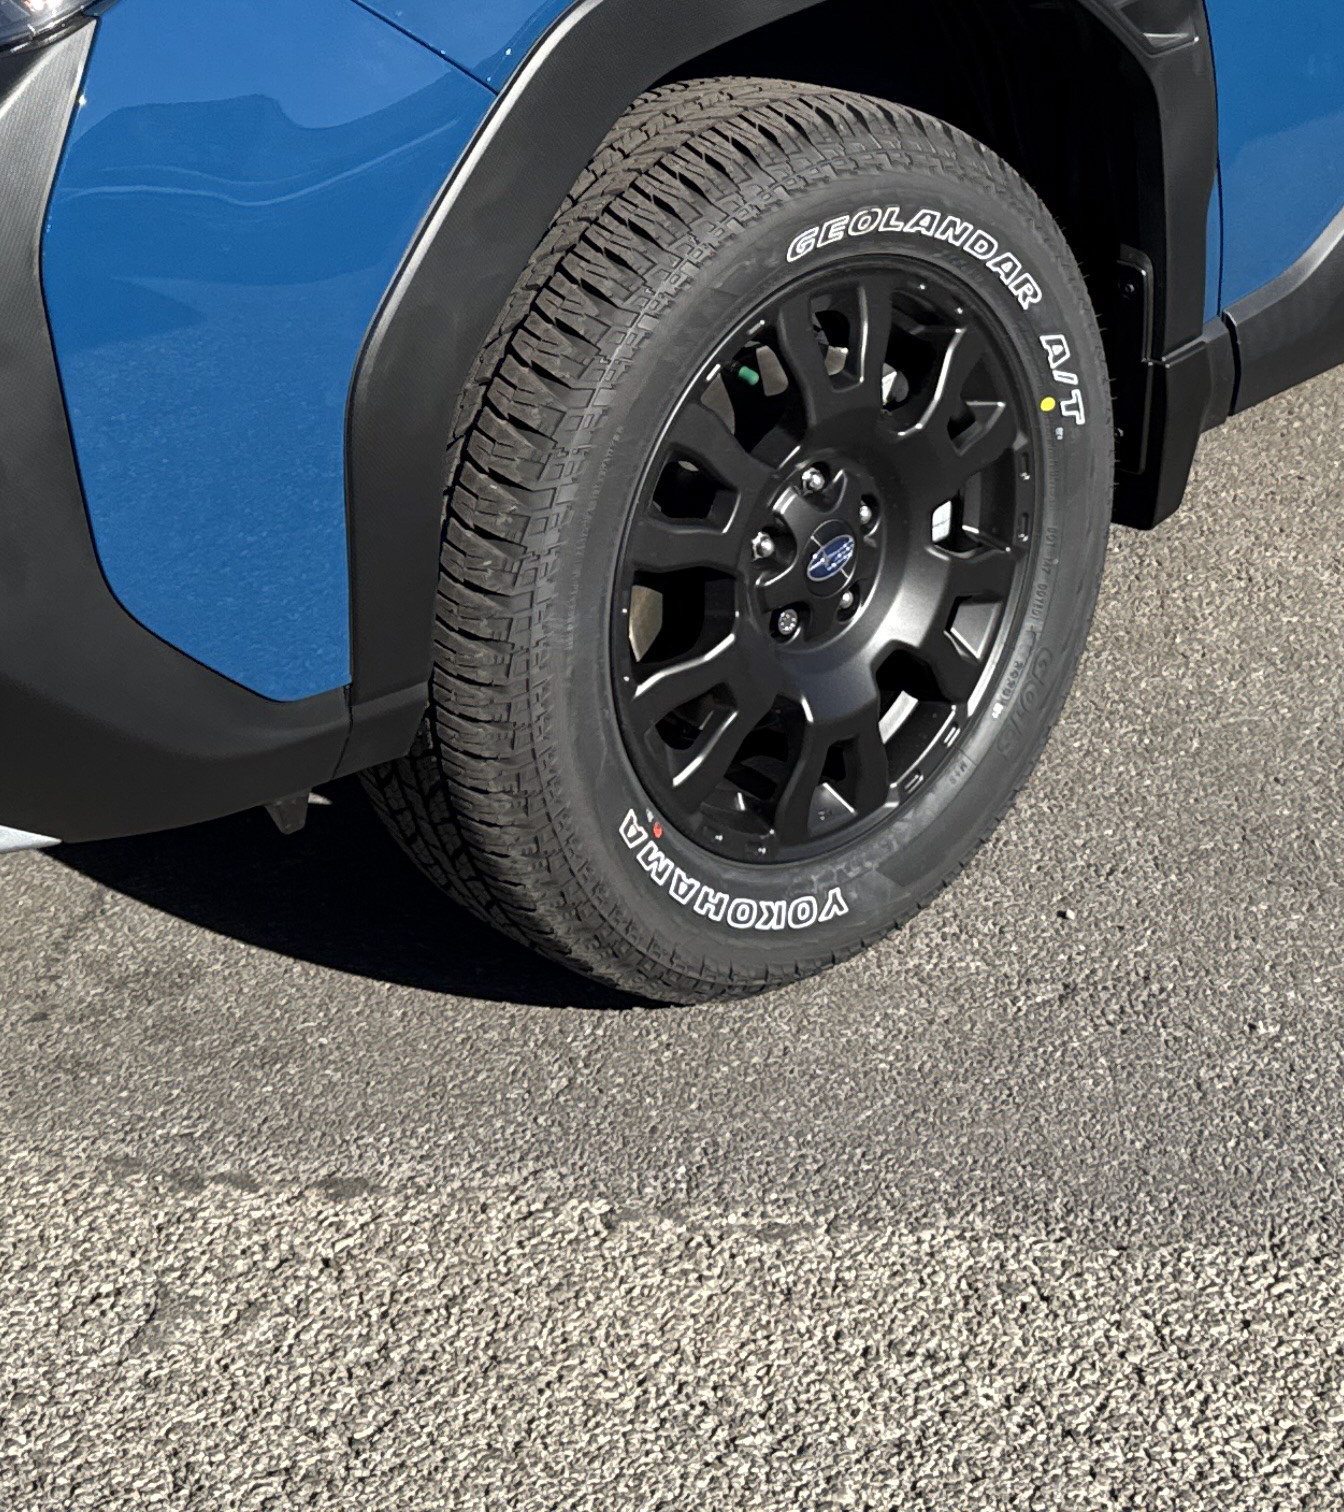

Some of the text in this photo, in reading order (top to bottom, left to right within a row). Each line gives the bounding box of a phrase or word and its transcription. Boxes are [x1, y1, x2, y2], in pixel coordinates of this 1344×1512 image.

[786, 206, 1085, 425] GEOLANDAR A/T
[619, 808, 849, 930] YOKOHAMA
